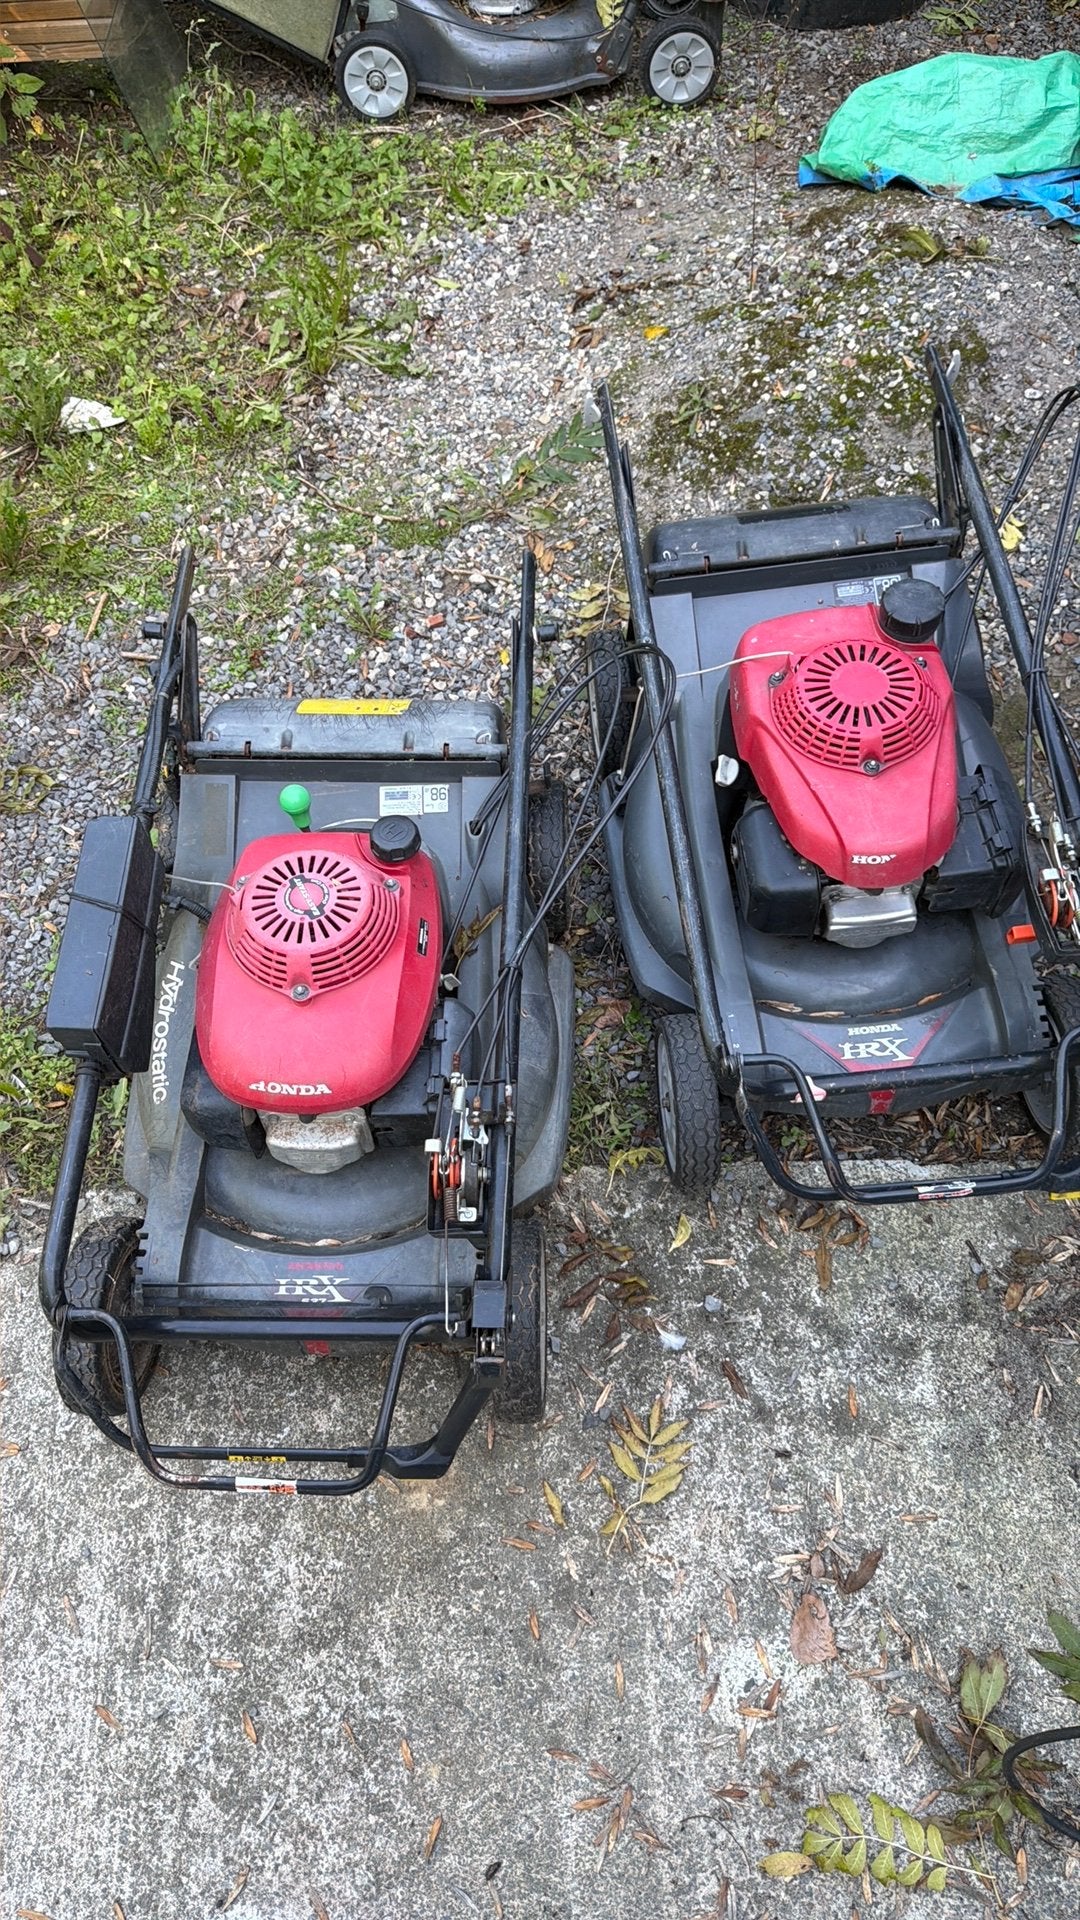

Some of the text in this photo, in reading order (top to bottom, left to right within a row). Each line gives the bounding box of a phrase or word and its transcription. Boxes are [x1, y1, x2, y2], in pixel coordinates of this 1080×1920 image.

[151, 960, 186, 1105] Hydrostatic
[847, 1023, 904, 1036] HONDA
[840, 1037, 915, 1061] HRX
[274, 1275, 351, 1303] HRX
